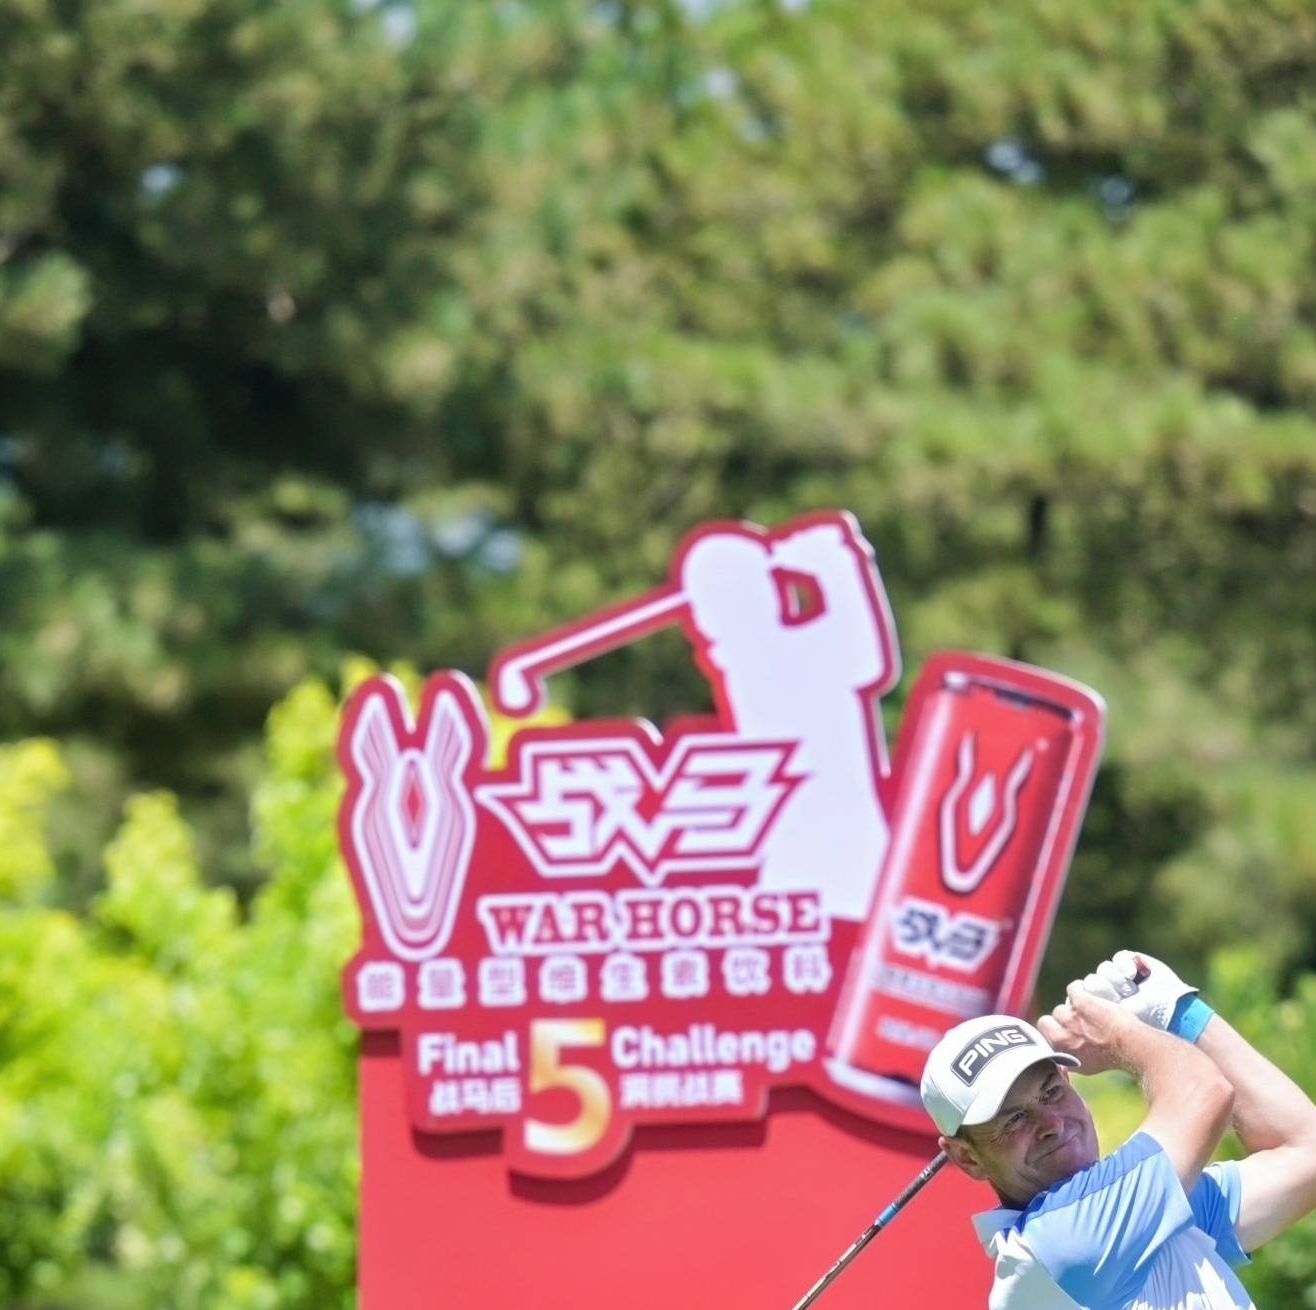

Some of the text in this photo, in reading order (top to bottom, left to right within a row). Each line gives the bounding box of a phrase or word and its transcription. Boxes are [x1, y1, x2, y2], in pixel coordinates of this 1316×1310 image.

[484, 892, 822, 948] WAR HORSE
[958, 1028, 1029, 1077] PING
[418, 1018, 816, 1154] Final 5 Challenge
